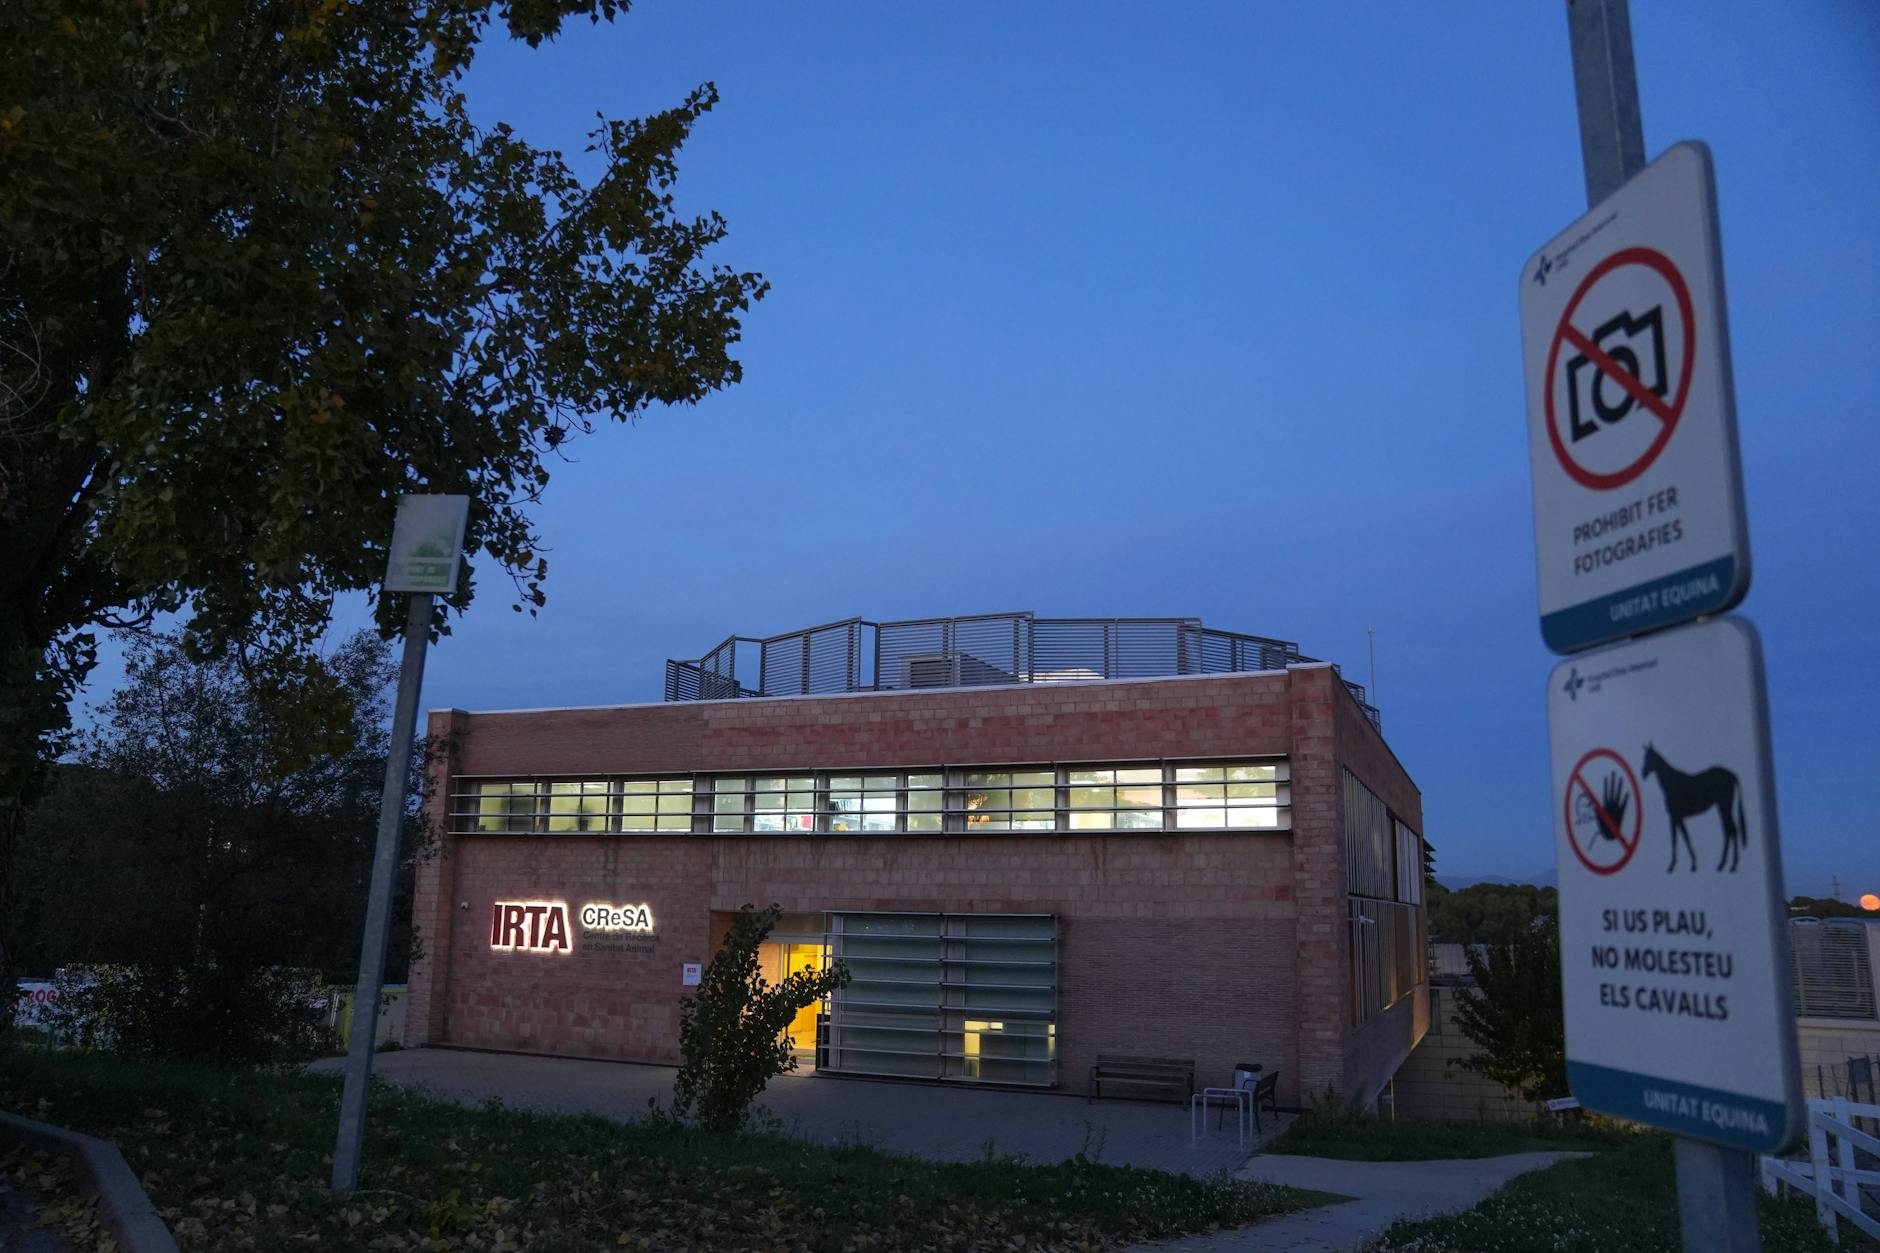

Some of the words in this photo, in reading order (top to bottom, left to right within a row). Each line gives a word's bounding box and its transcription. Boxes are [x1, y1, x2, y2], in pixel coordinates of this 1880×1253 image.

[1573, 500, 1642, 545] PROHIBIT
[1647, 487, 1678, 515] FER
[1573, 519, 1683, 575] FOTOGRAFIES
[1609, 592, 1659, 622] UNITAT
[1661, 573, 1719, 607] EQUINA
[491, 903, 569, 949] IRTA
[582, 907, 649, 927] CReSA
[1603, 909, 1618, 931] SI
[1624, 910, 1647, 932] US
[1653, 910, 1713, 939] PLAU,
[1592, 947, 1618, 968] NO
[1624, 948, 1733, 978] MOLESTEU
[1600, 983, 1630, 1008] ELS
[1635, 987, 1728, 1021] CAVALLS
[1643, 1089, 1699, 1119] UNITAT
[1702, 1102, 1769, 1136] EQUINA
